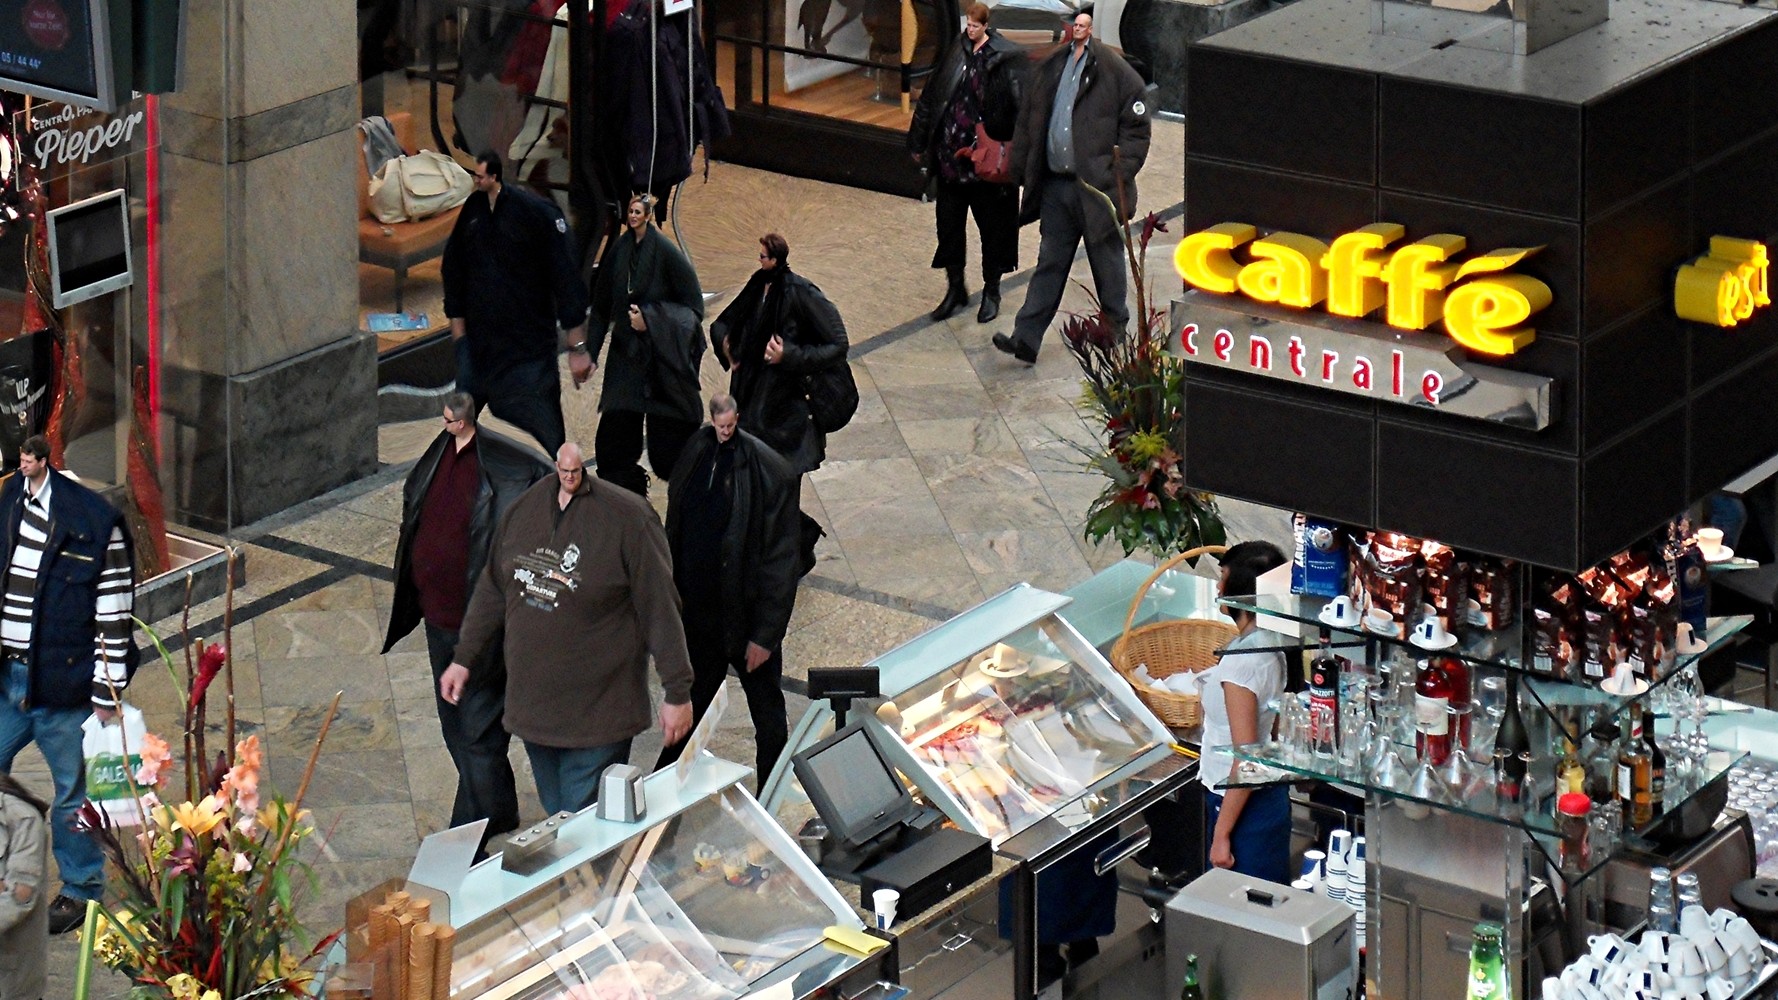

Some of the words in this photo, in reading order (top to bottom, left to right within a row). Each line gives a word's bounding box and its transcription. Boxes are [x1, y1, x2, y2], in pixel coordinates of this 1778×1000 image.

[34, 111, 143, 170] Pieper
[1173, 222, 1553, 356] caffé
[1181, 322, 1444, 405] centrale
